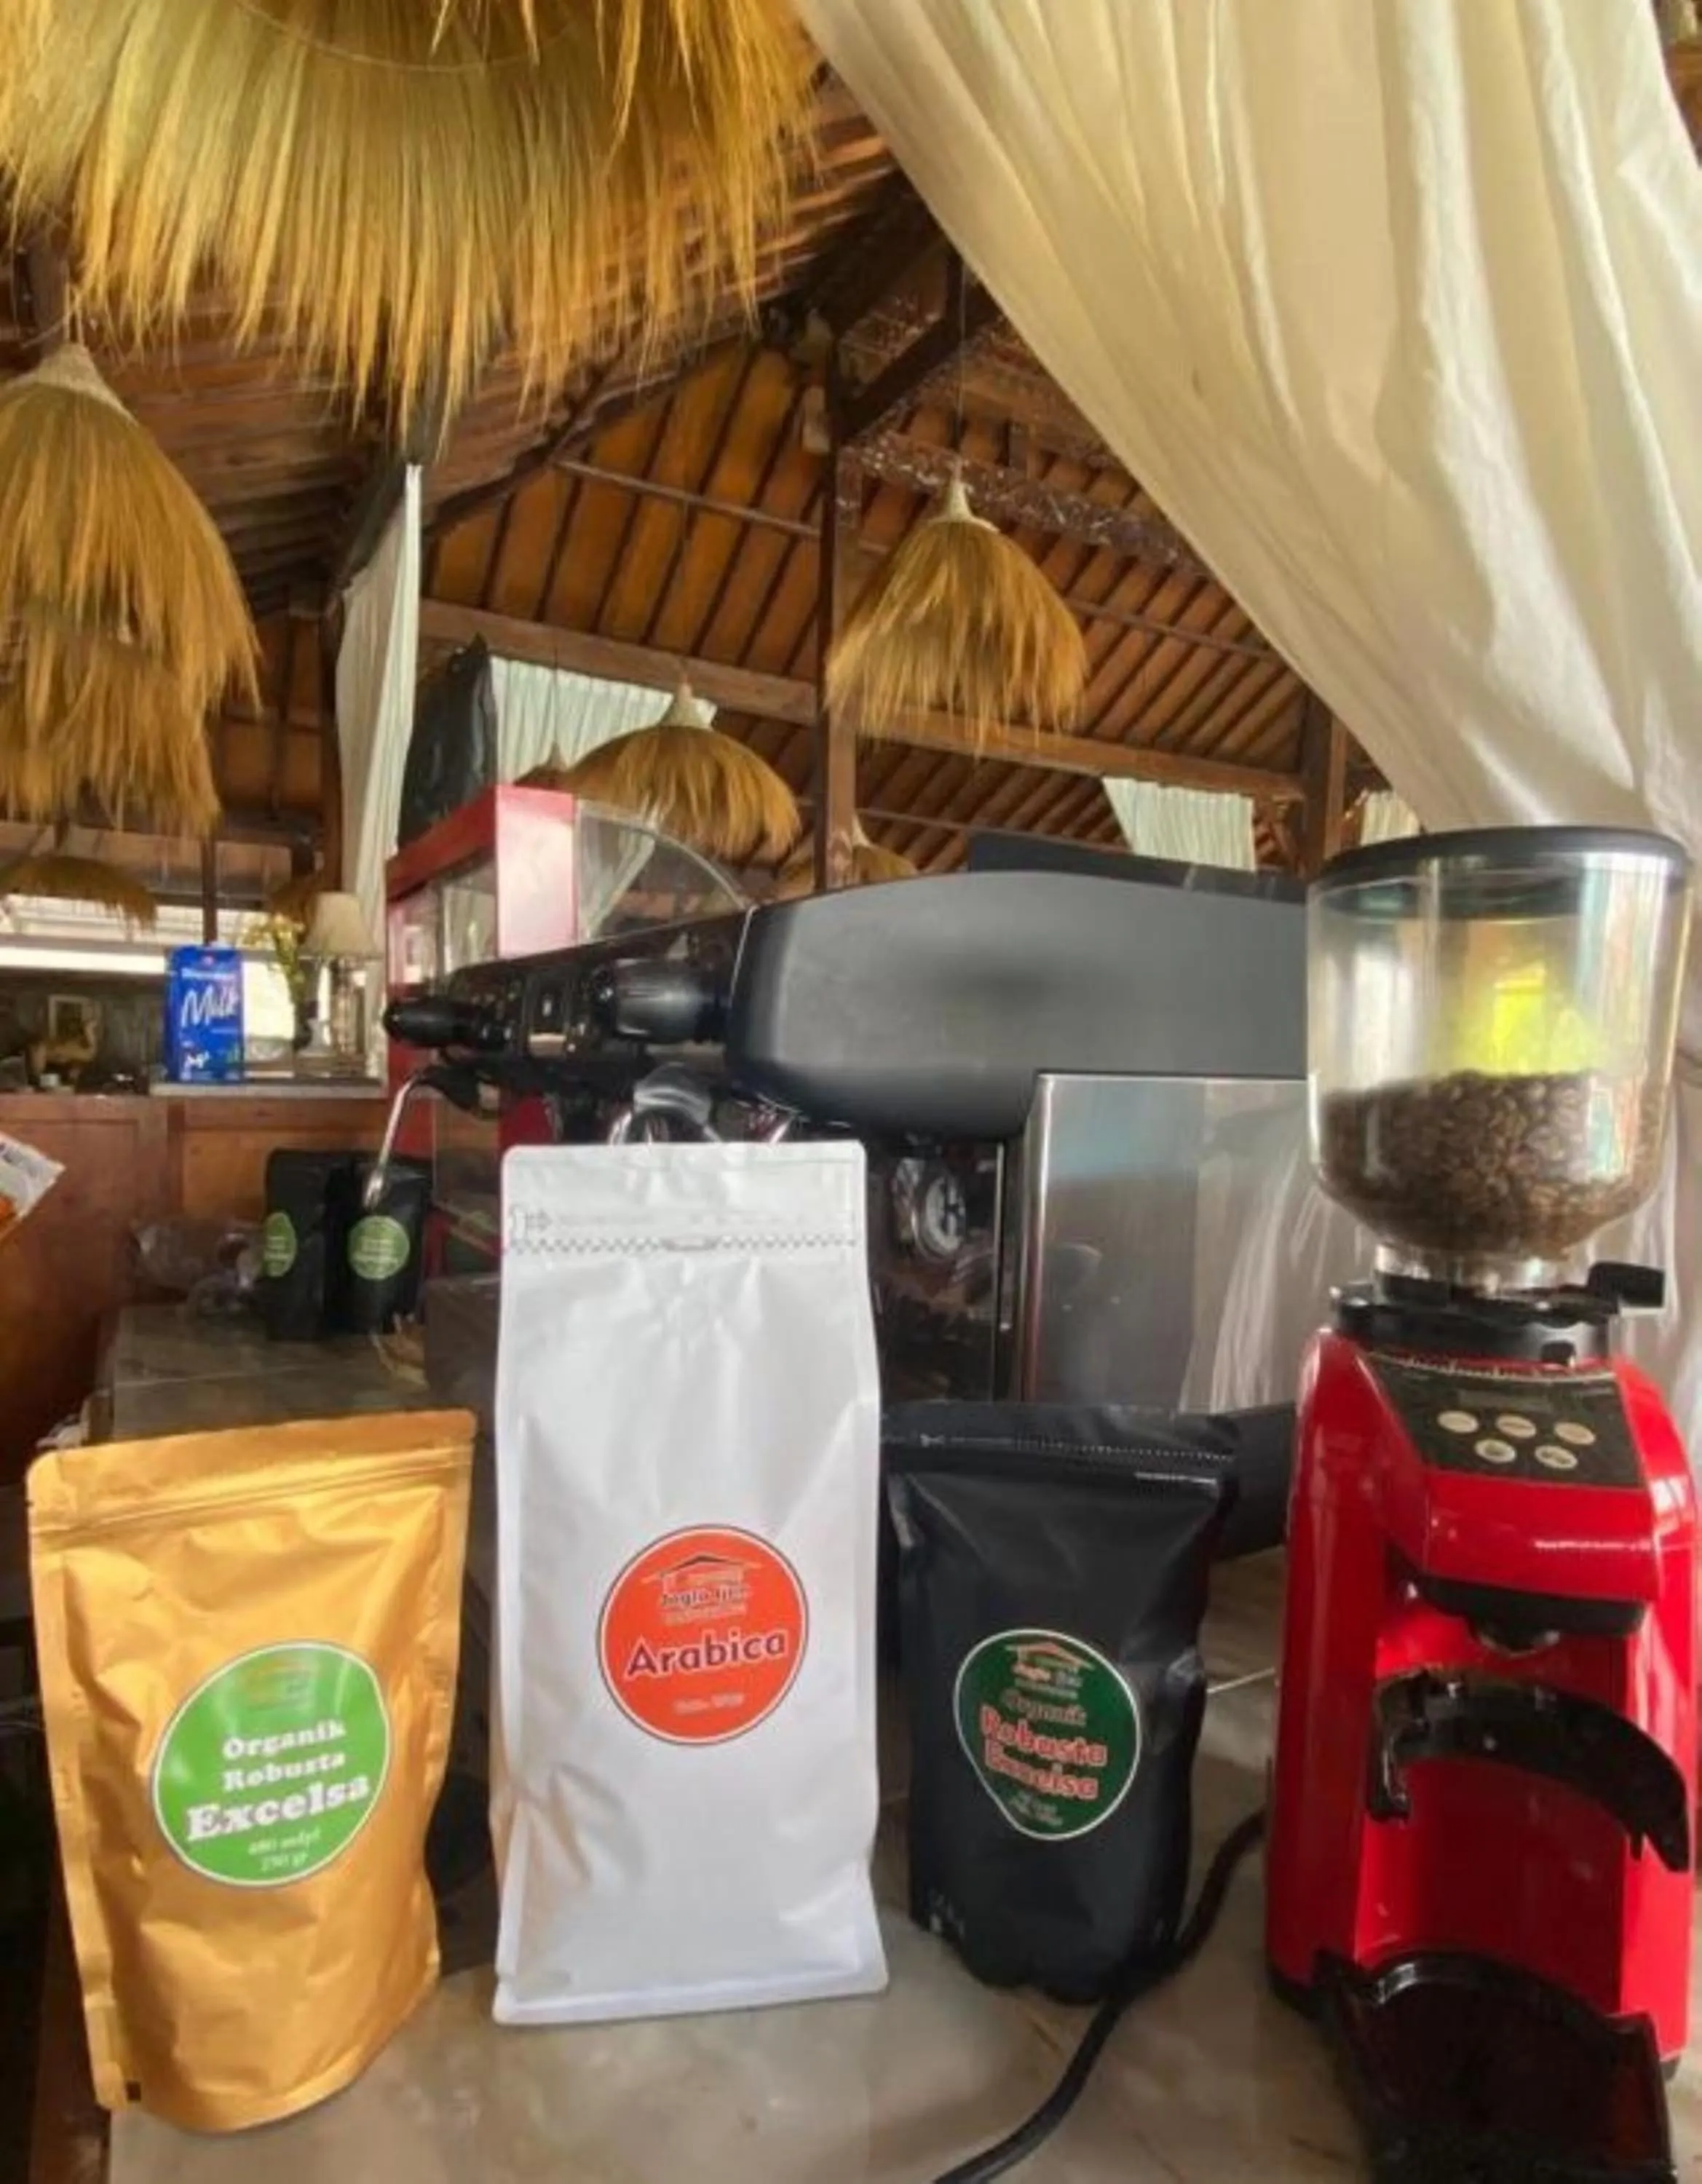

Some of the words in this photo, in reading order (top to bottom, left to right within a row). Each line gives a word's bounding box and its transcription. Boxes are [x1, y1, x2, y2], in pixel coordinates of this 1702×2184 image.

[182, 985, 239, 1027] Milk
[624, 1627, 788, 1679] Arabica
[223, 1720, 345, 1759] Organik
[981, 1705, 1107, 1766] Robusta
[224, 1752, 346, 1792] Robusta
[187, 1775, 368, 1841] Excelsa
